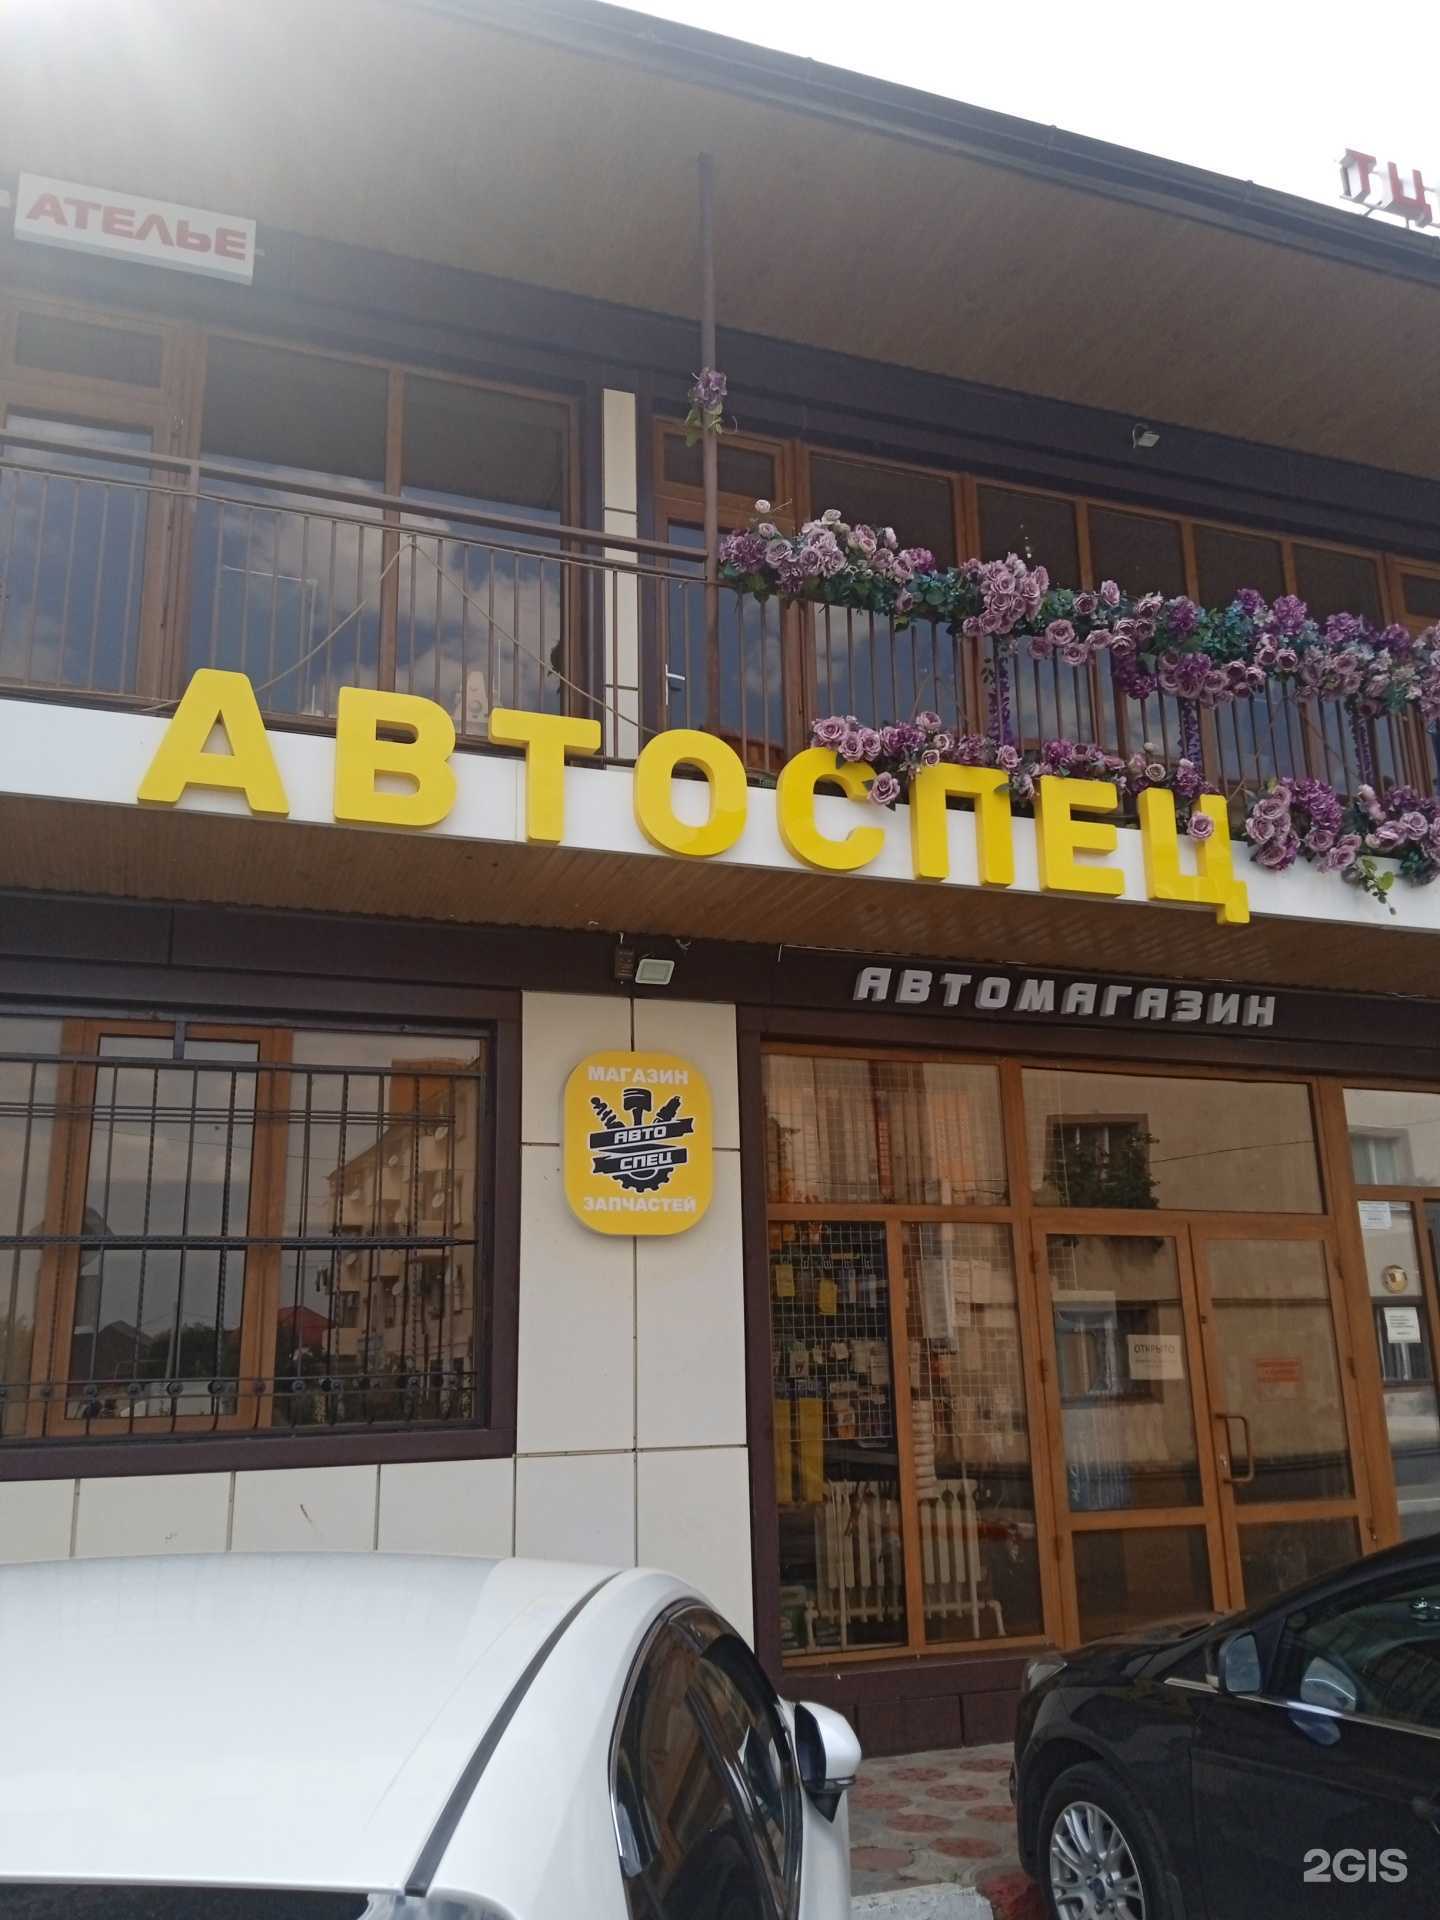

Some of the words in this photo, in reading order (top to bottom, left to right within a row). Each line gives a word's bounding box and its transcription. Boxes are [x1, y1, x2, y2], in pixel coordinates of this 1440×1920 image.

[26, 192, 247, 260] АТЕЛЬЕ
[137, 668, 1250, 924] АВТОСПЕЦ
[854, 967, 1276, 1026] АВТОМАГАЗИН
[588, 1066, 689, 1085] МАГАЗИН
[614, 1126, 667, 1144] АВТО
[620, 1152, 673, 1170] СПЕЦ
[583, 1196, 697, 1213] ЗАПЧАСТЕЙ
